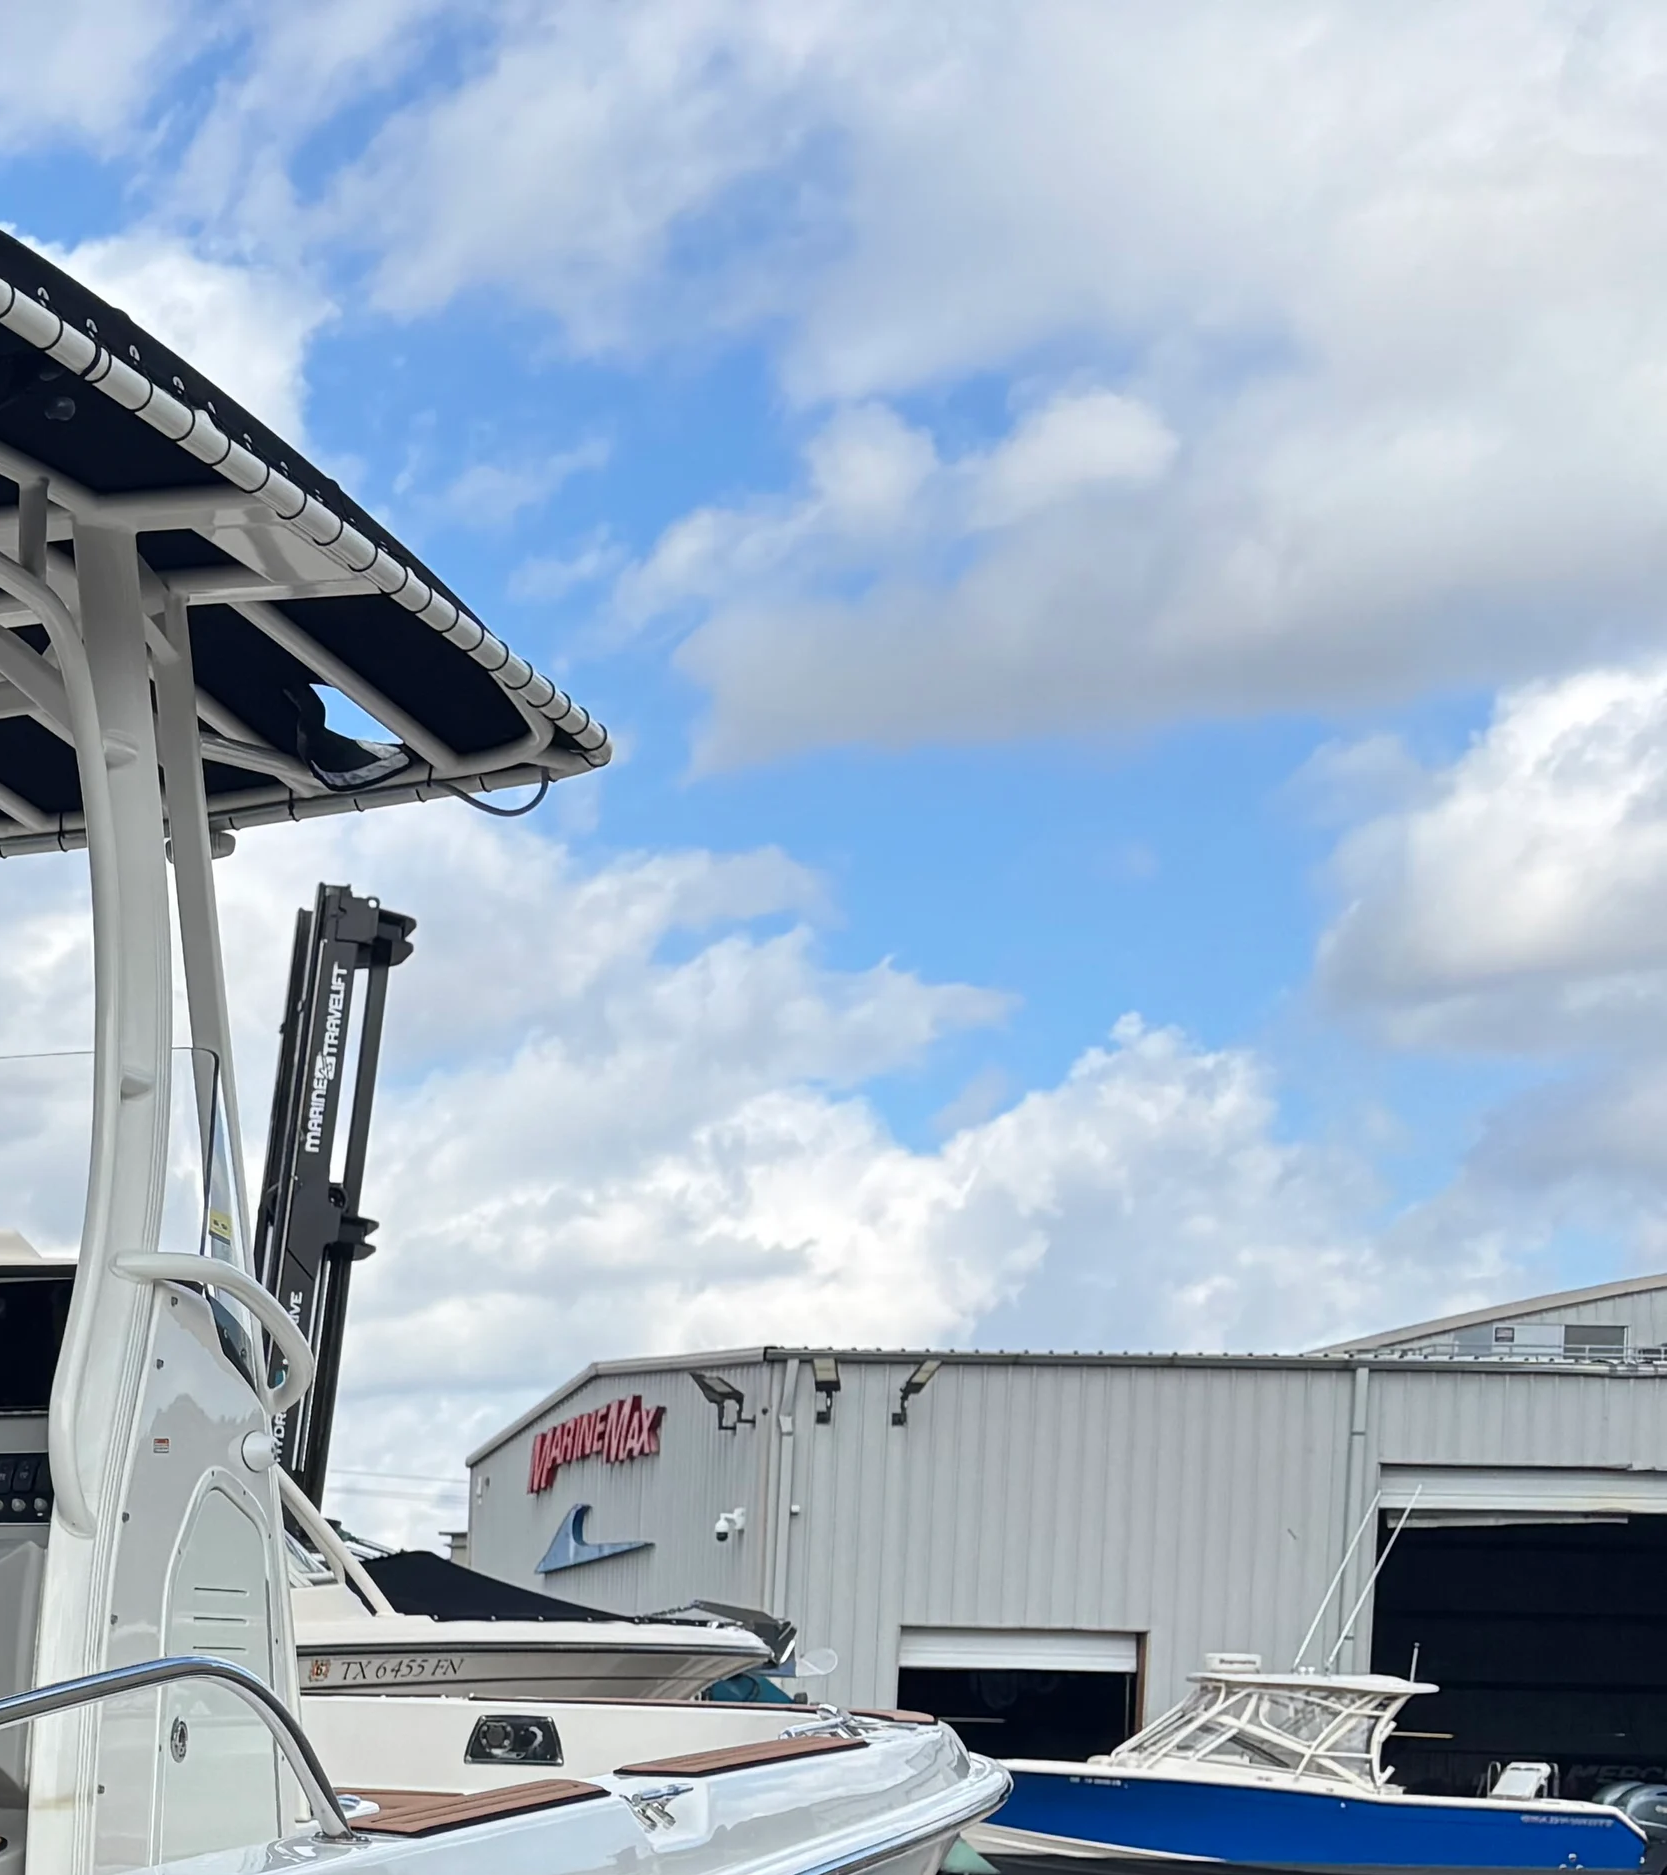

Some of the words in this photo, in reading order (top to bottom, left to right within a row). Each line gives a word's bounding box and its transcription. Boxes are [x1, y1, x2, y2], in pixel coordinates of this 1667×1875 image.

[305, 1078, 328, 1154] MARINE
[321, 963, 349, 1056] TRAVELIFT
[341, 1660, 371, 1681] TX
[375, 1658, 429, 1680] 6455
[430, 1657, 464, 1677] FN
